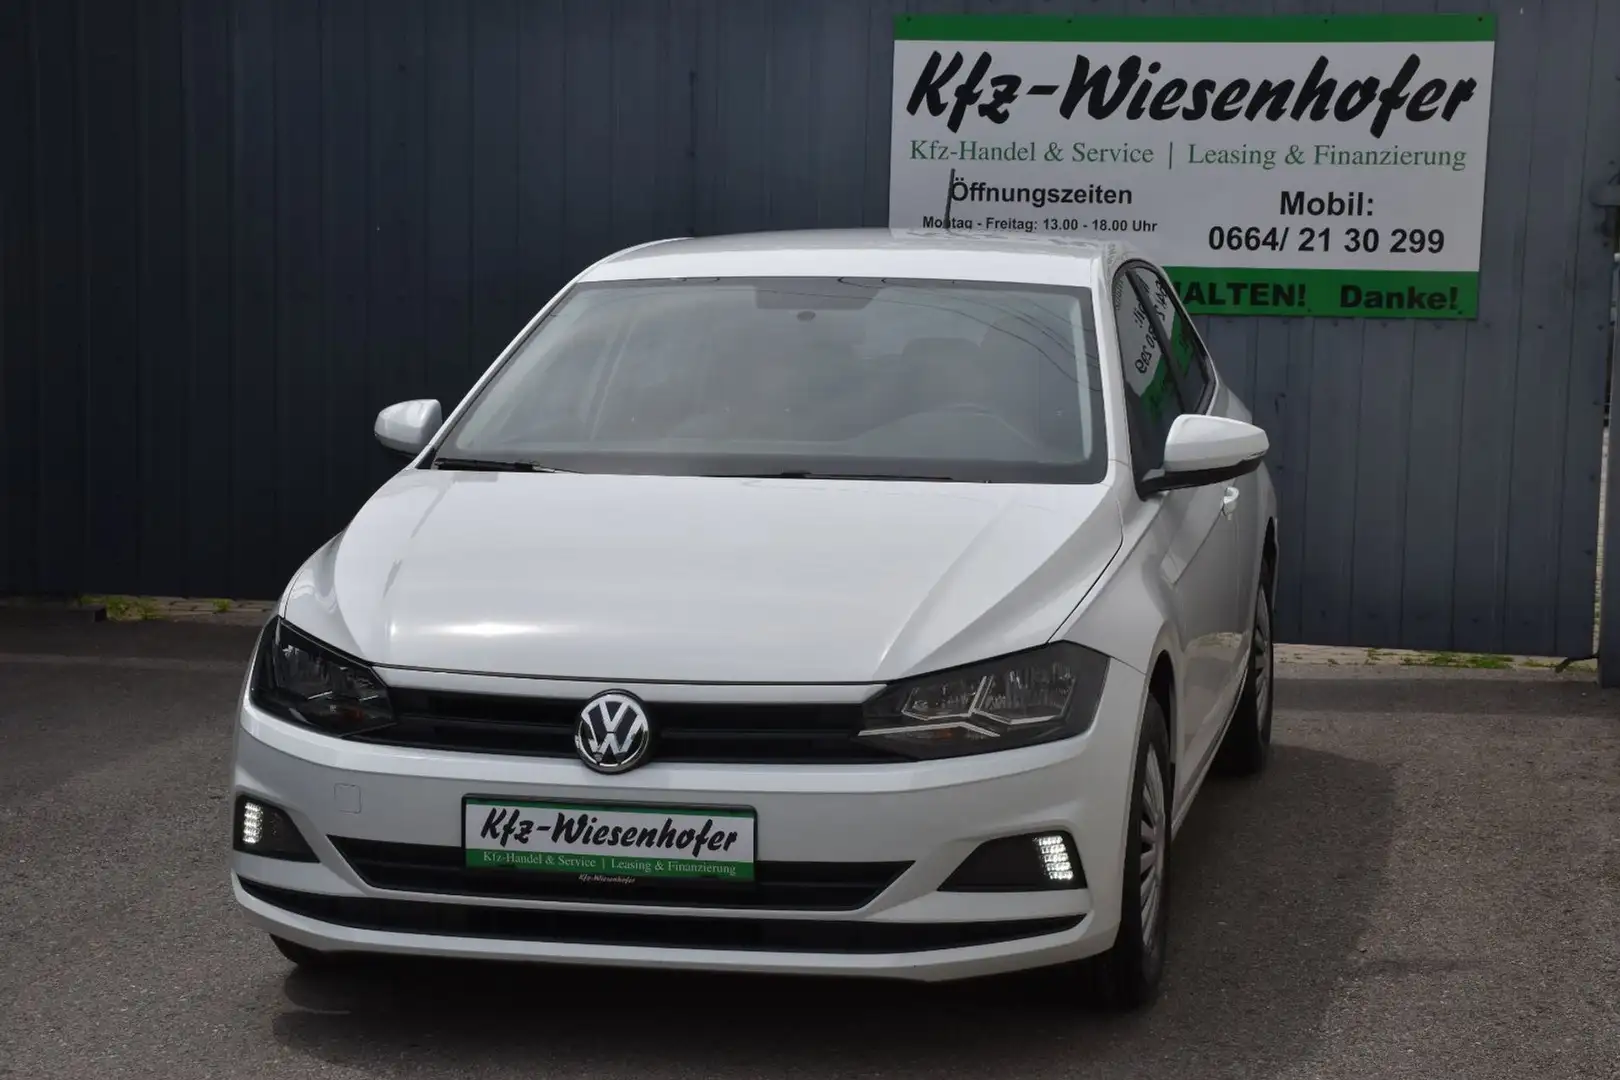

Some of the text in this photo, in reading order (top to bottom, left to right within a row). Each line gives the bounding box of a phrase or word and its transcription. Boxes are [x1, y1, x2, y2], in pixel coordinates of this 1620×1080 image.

[906, 50, 1477, 138] Kfz-Wiesenhofer
[909, 140, 1036, 162] Kfz-Handel
[1044, 142, 1064, 162] &
[1072, 143, 1154, 163] Service
[1189, 144, 1277, 170] Leasing
[1285, 145, 1305, 165] &
[1314, 145, 1467, 171] Finanzierung
[951, 177, 1132, 207] Öffnungszeiten
[1280, 191, 1374, 217] Mobil:
[986, 217, 1038, 232] Freitag:
[1043, 218, 1078, 231] 13.00
[1092, 219, 1128, 232] 18.00
[1132, 219, 1158, 232] Uhr
[1208, 226, 1445, 254] 0664/ 21 30 299
[1340, 284, 1458, 310] Danke!
[480, 807, 738, 858] Kfz-Wiesenhofer
[483, 851, 543, 865] Kfz-Handel
[545, 855, 554, 866] &
[558, 855, 596, 868] Service
[611, 857, 651, 872] Leasing
[654, 860, 664, 872] &
[668, 861, 736, 877] Finanzierung
